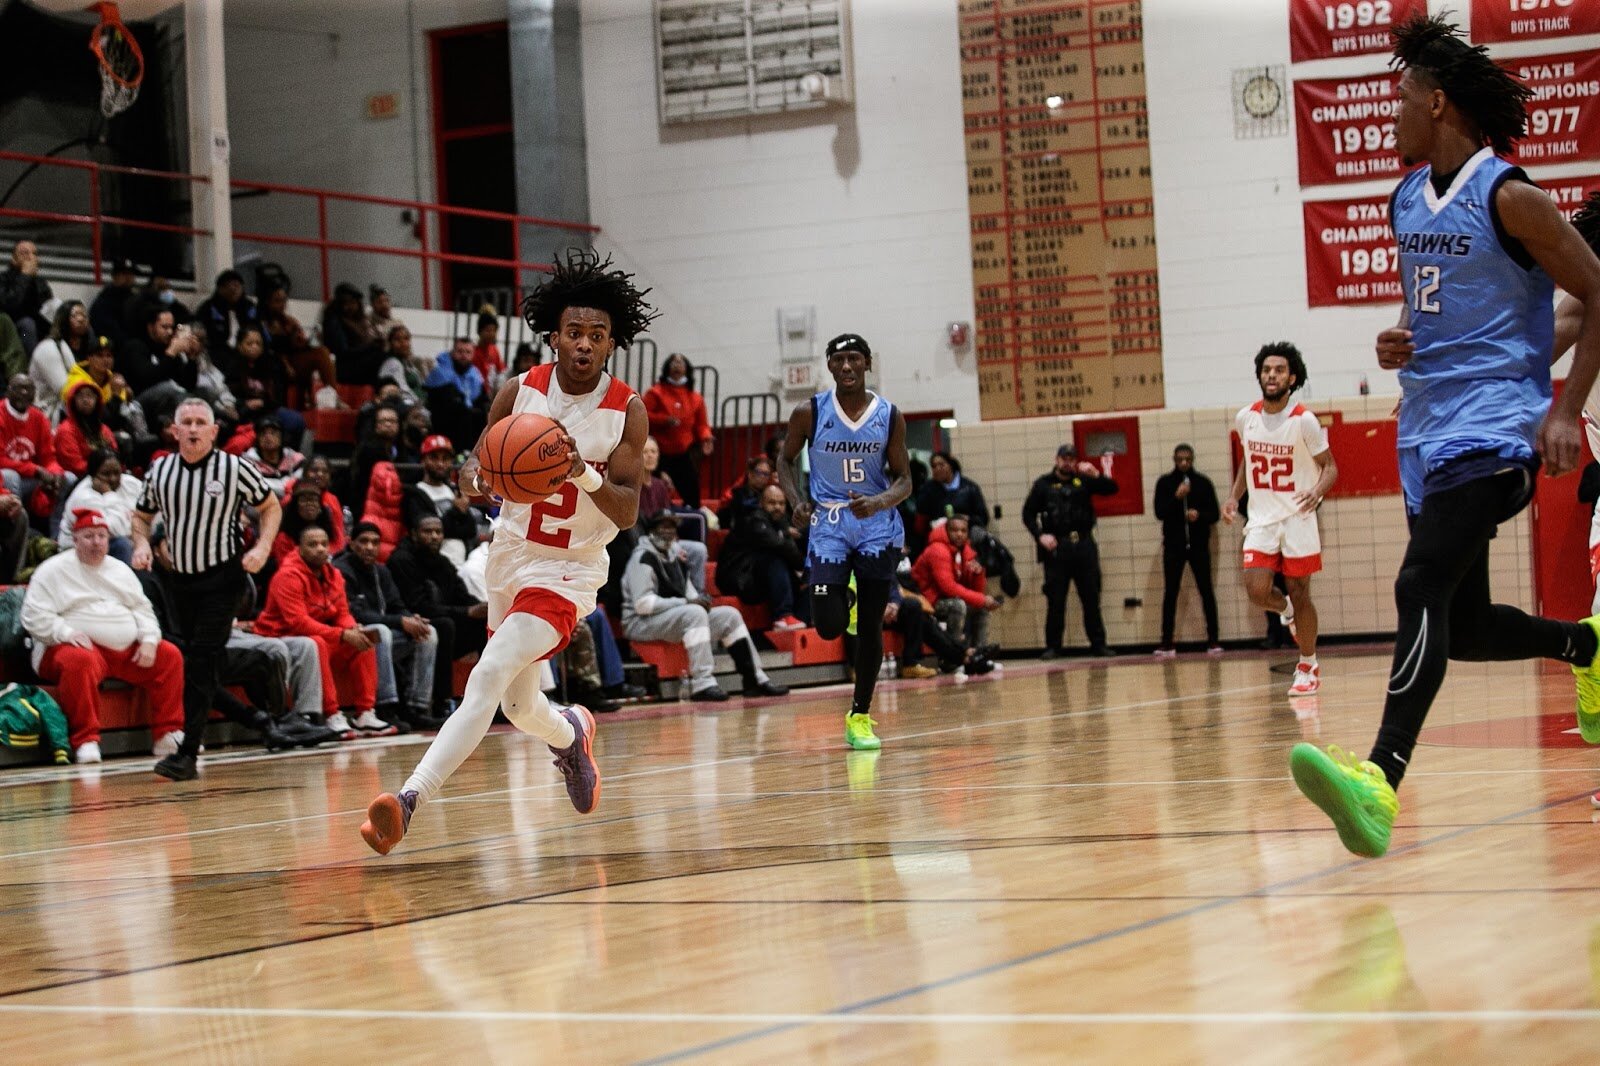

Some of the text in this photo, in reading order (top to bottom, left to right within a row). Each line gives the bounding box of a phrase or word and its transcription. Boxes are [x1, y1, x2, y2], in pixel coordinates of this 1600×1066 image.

[1325, 0, 1392, 31] 1992
[1510, 15, 1570, 34] BOYS TRACK
[1332, 32, 1390, 53] BOYS TRACK
[1520, 62, 1575, 80] STATE
[1336, 80, 1391, 100] STATE
[1526, 80, 1600, 102] MPIONS
[1332, 123, 1397, 154] 1992
[1519, 140, 1579, 158] BOYS TRACK
[1336, 156, 1400, 176] GIRLS TRACK
[1546, 186, 1583, 203] ATE
[1347, 203, 1390, 220] STAT
[1321, 225, 1394, 244] CHAMPI
[1399, 231, 1473, 257] HAWKS
[1341, 246, 1398, 276] 1987
[1336, 284, 1369, 299] GIRLS
[1413, 265, 1441, 314] 12
[825, 441, 881, 453] HAWKS
[1248, 440, 1294, 455] BEECHER
[843, 459, 865, 482] 15
[1250, 454, 1295, 492] 22
[526, 480, 579, 549] 2
